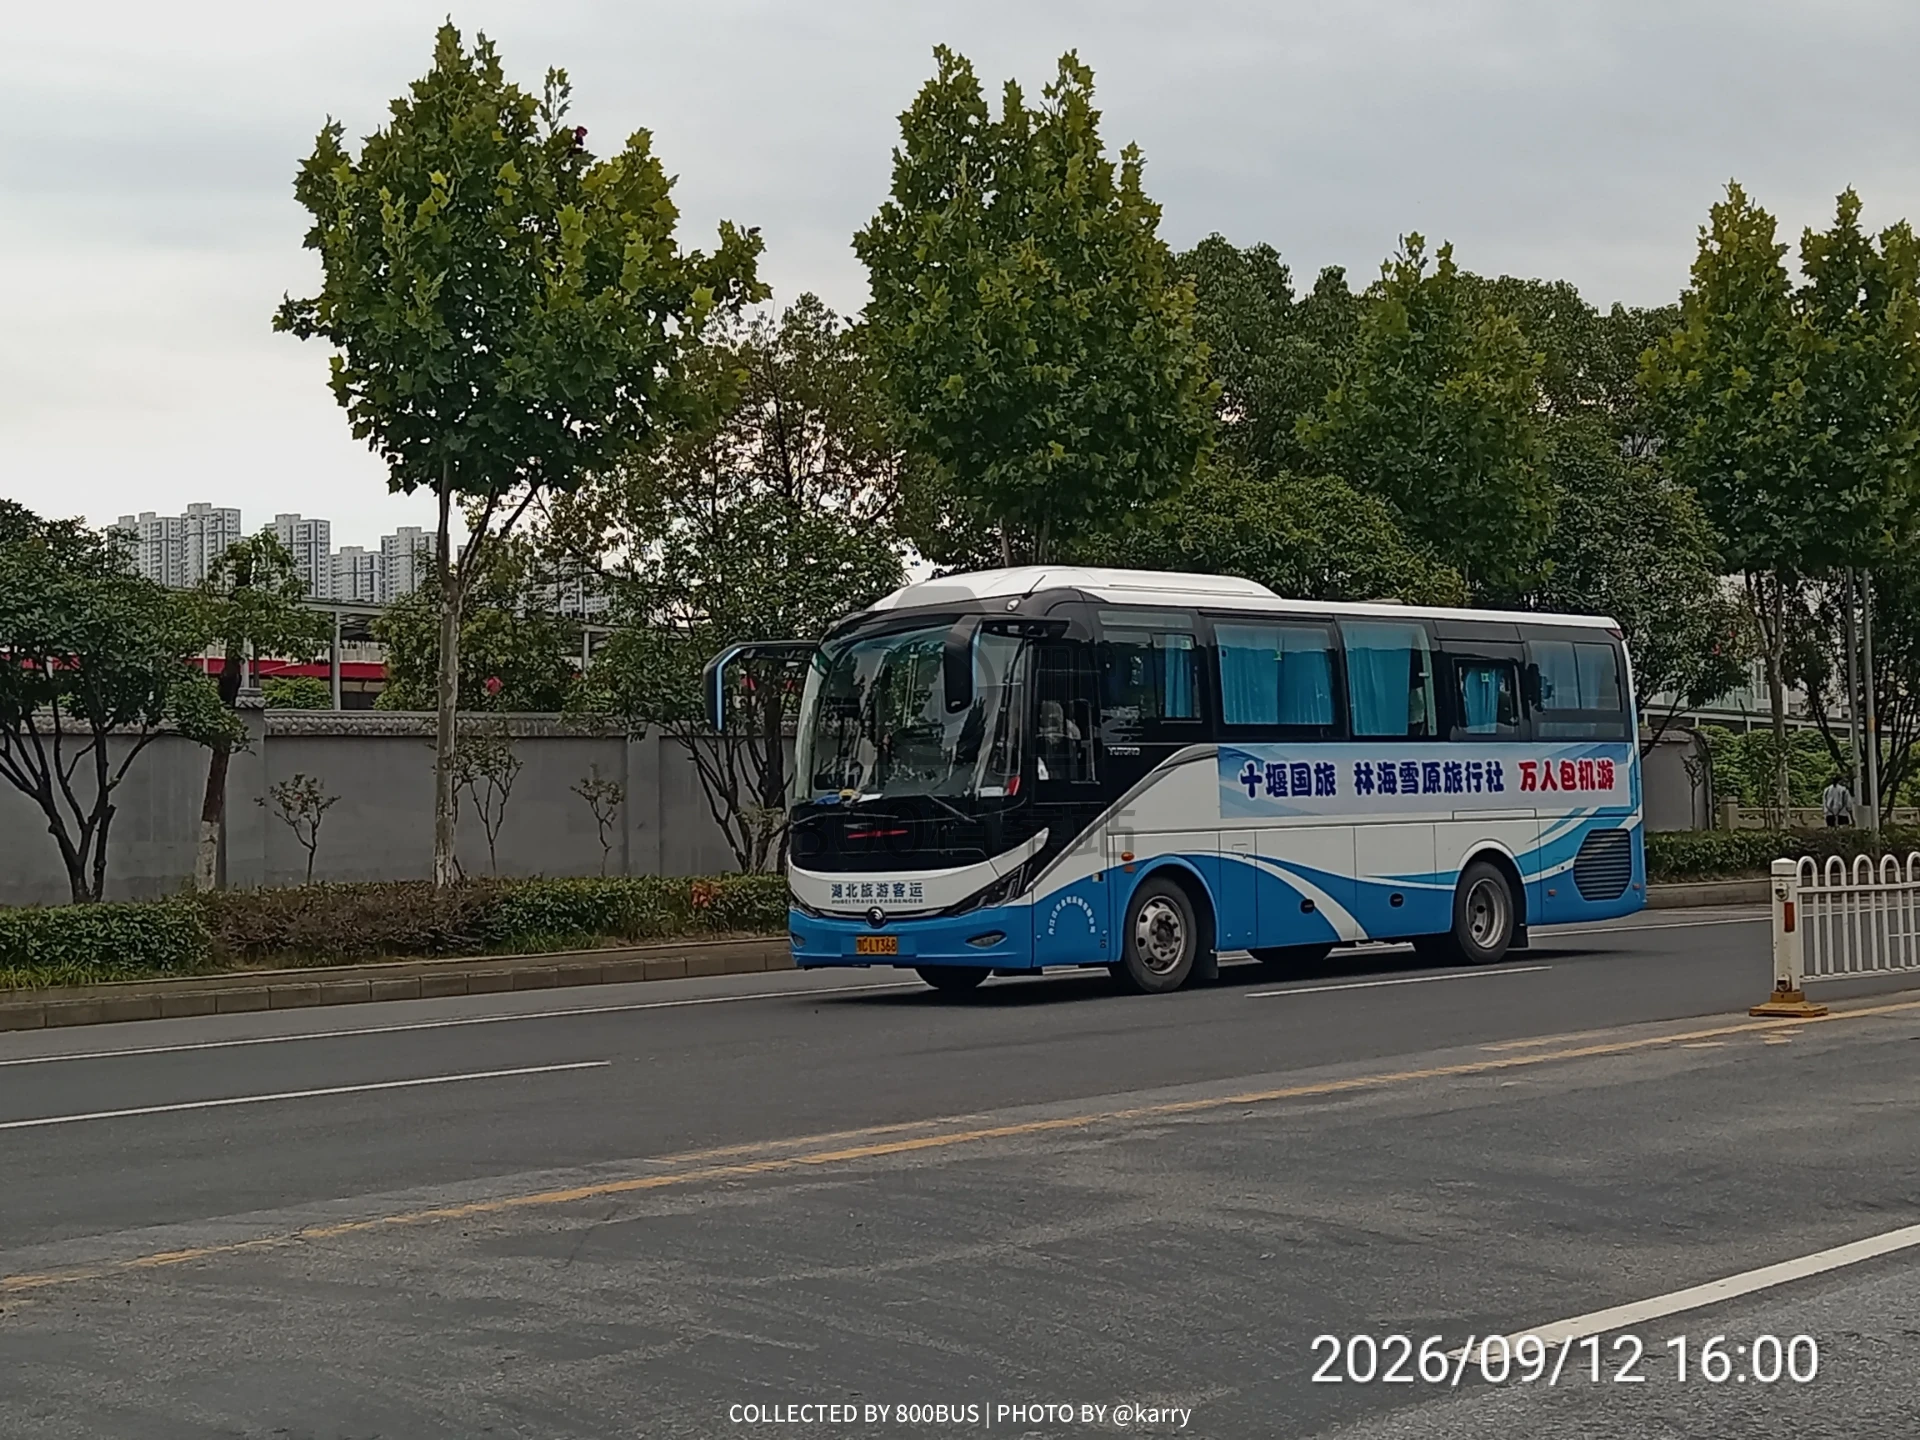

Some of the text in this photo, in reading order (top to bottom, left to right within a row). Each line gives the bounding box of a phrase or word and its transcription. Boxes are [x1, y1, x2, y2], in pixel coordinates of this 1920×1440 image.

[1240, 759, 1616, 798] 十堰国旅 林海雪原旅行社 万人包机游
[831, 882, 923, 898] 湖北旅游客运
